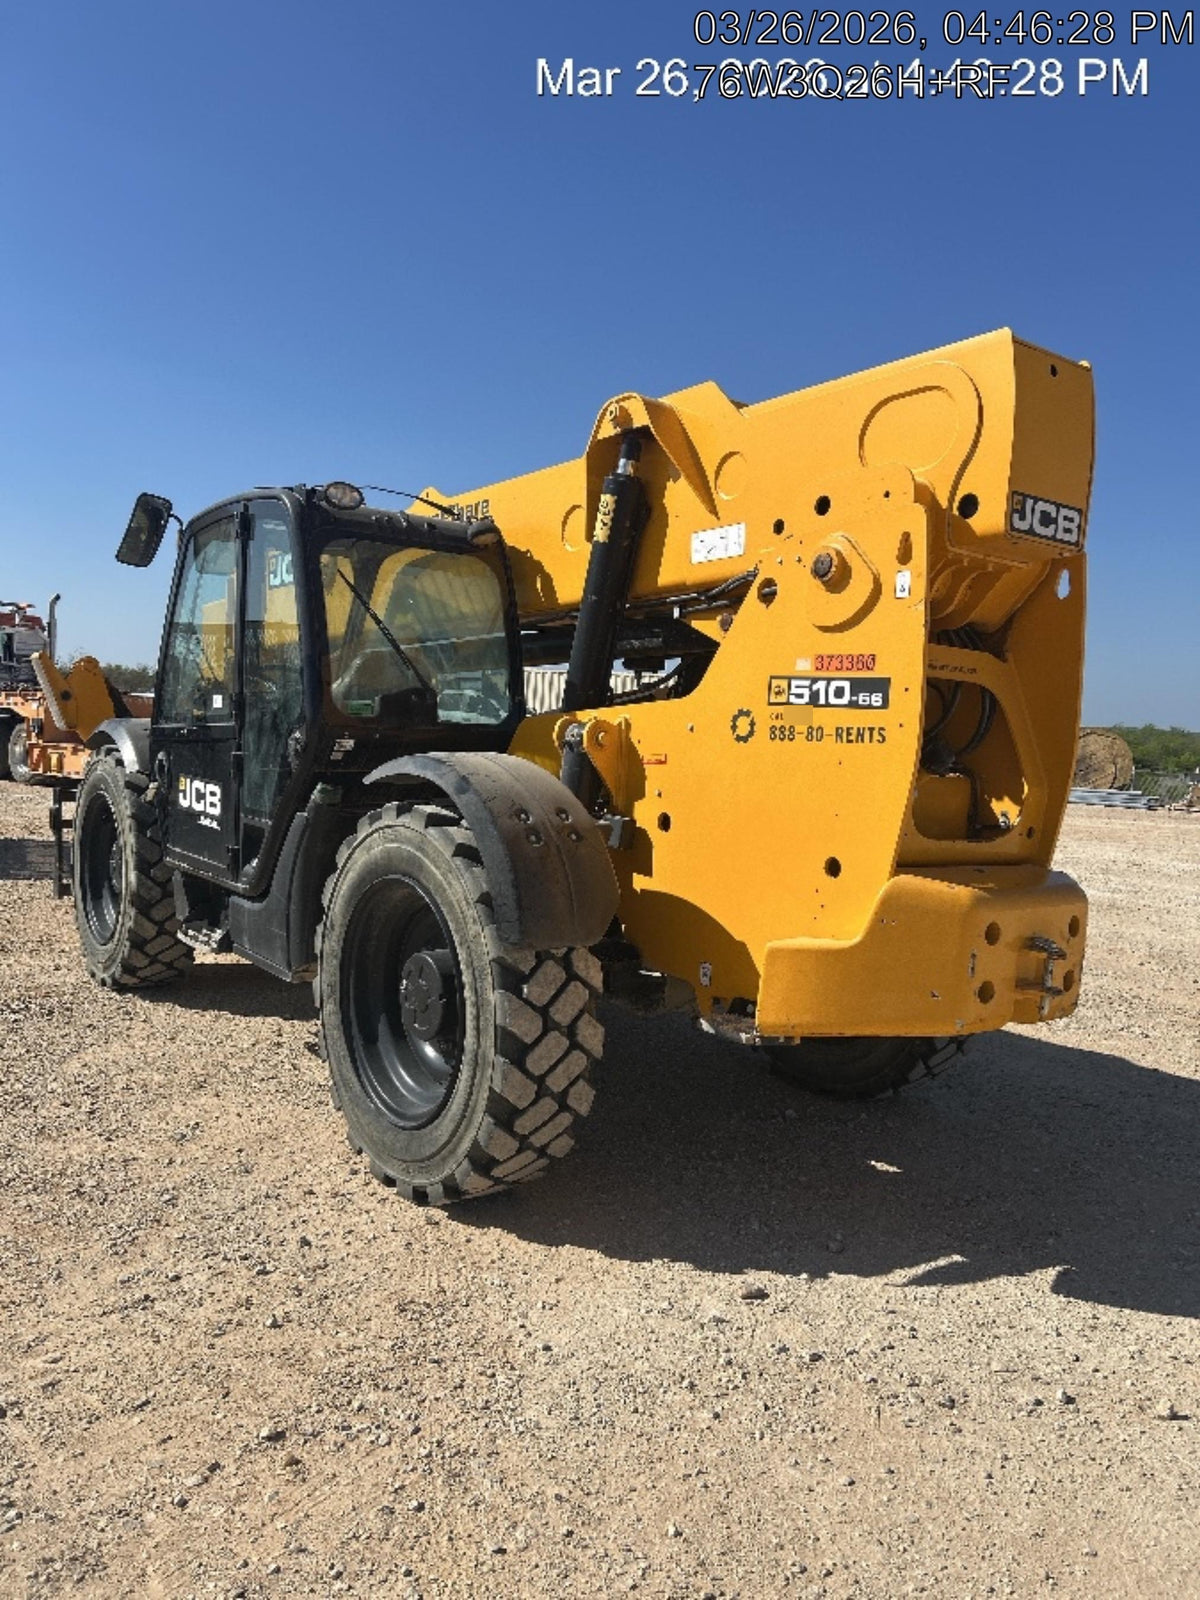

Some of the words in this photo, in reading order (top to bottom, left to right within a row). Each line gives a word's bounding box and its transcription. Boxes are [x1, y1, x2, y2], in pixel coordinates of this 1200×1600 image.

[1012, 498, 1081, 543] JCB
[269, 553, 294, 586] JC
[179, 778, 221, 816] JCB
